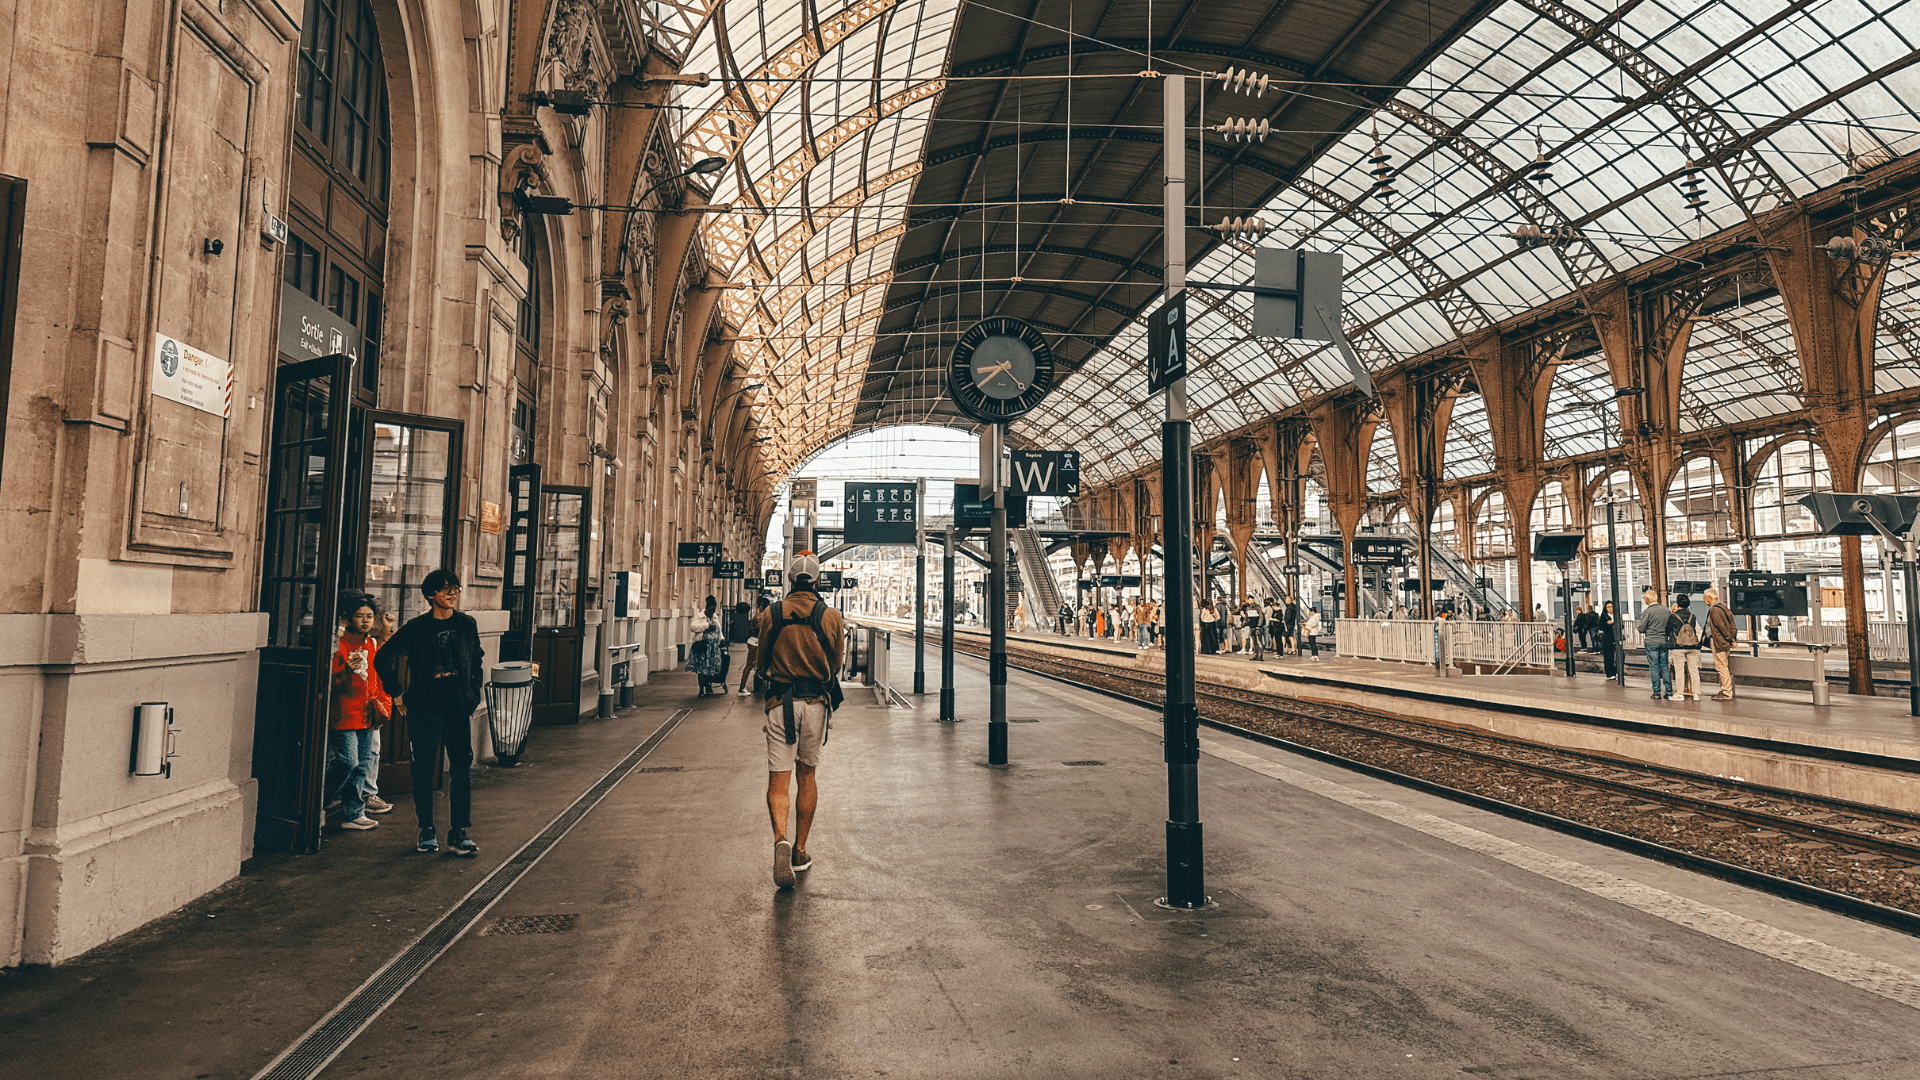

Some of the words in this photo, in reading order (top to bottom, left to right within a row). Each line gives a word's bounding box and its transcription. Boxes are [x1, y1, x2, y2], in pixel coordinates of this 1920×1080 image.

[301, 316, 324, 343] Sortie
[1168, 327, 1179, 367] A
[183, 349, 204, 366] Danger
[1063, 458, 1074, 469] A
[1014, 461, 1055, 493] W
[877, 492, 885, 501] B
[890, 492, 898, 501] C
[903, 492, 912, 501] D
[877, 512, 884, 521] E
[891, 512, 898, 521] F
[903, 512, 912, 521] G
